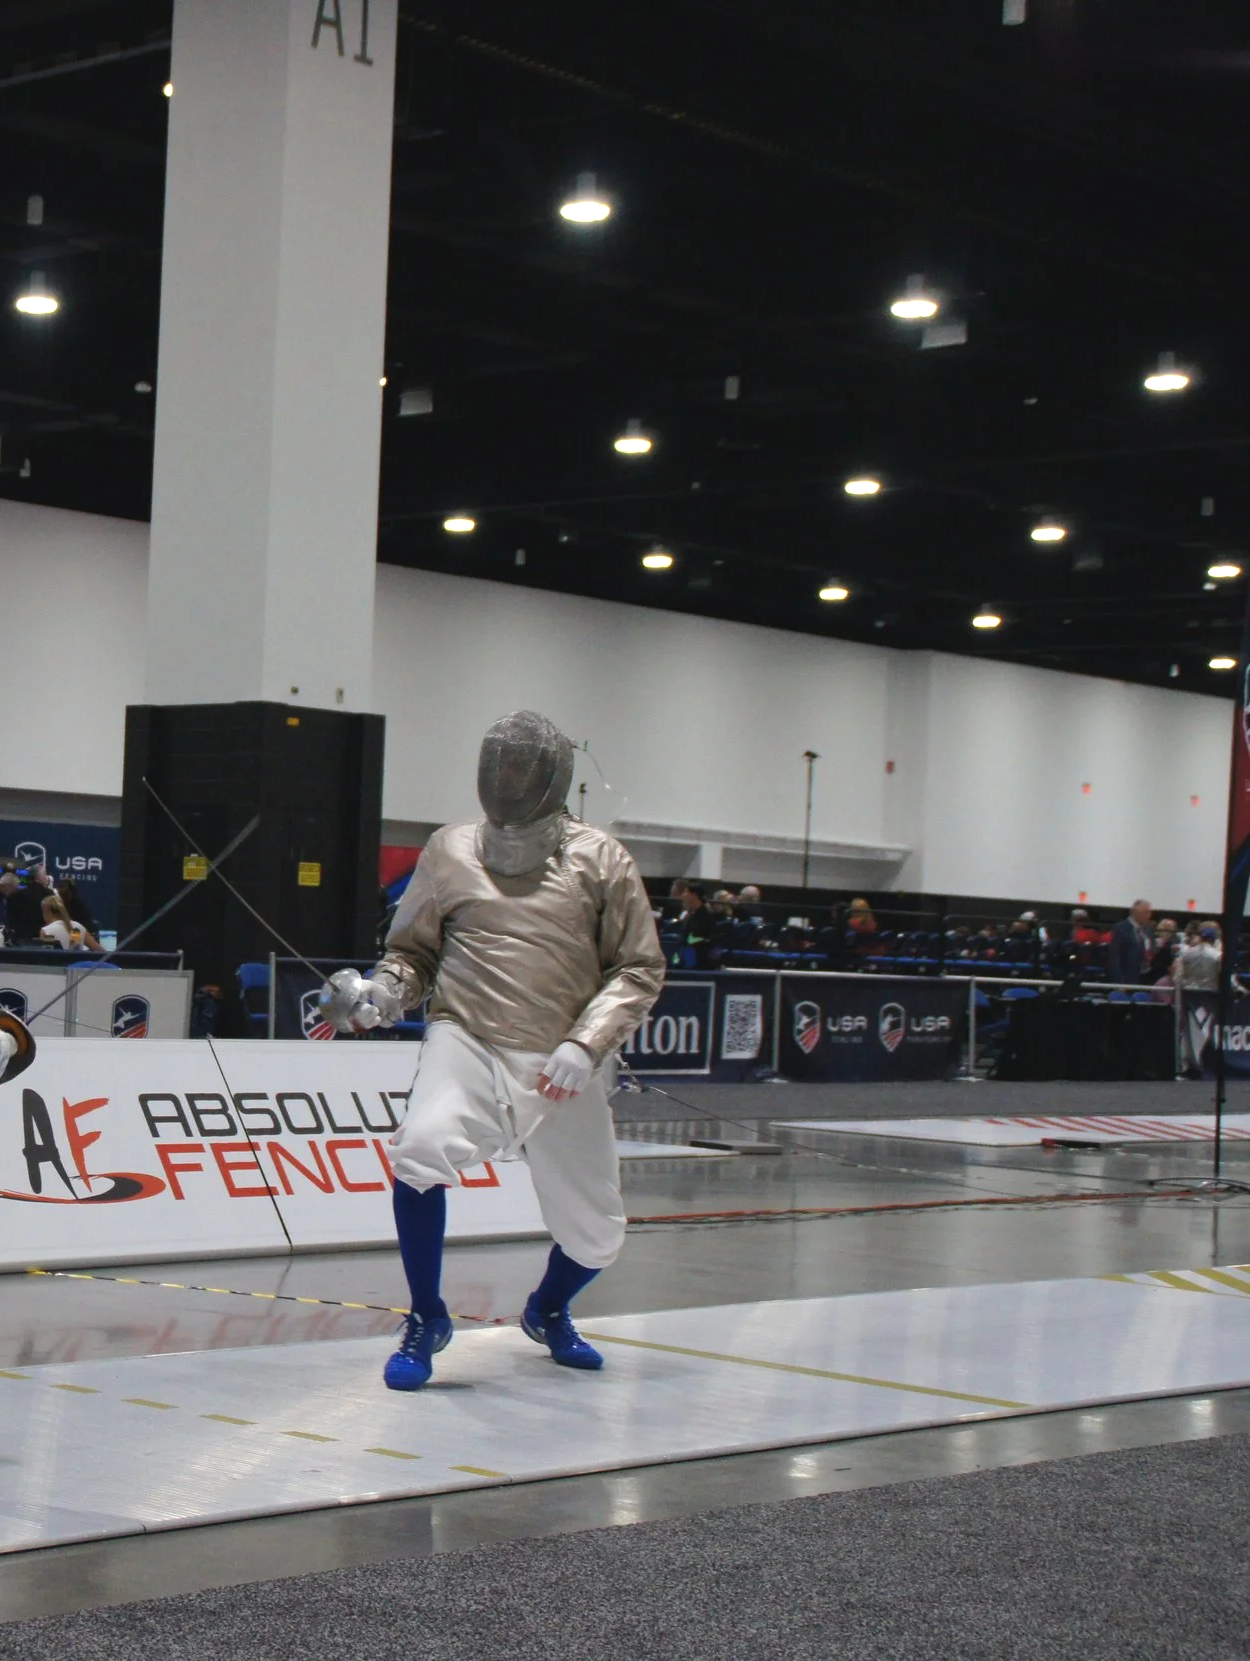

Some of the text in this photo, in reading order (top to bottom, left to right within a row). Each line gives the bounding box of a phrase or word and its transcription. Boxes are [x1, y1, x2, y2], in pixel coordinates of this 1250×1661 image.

[55, 856, 102, 870] USA
[826, 1016, 868, 1031] USA
[910, 1016, 950, 1031] USA
[22, 1088, 110, 1200] AF
